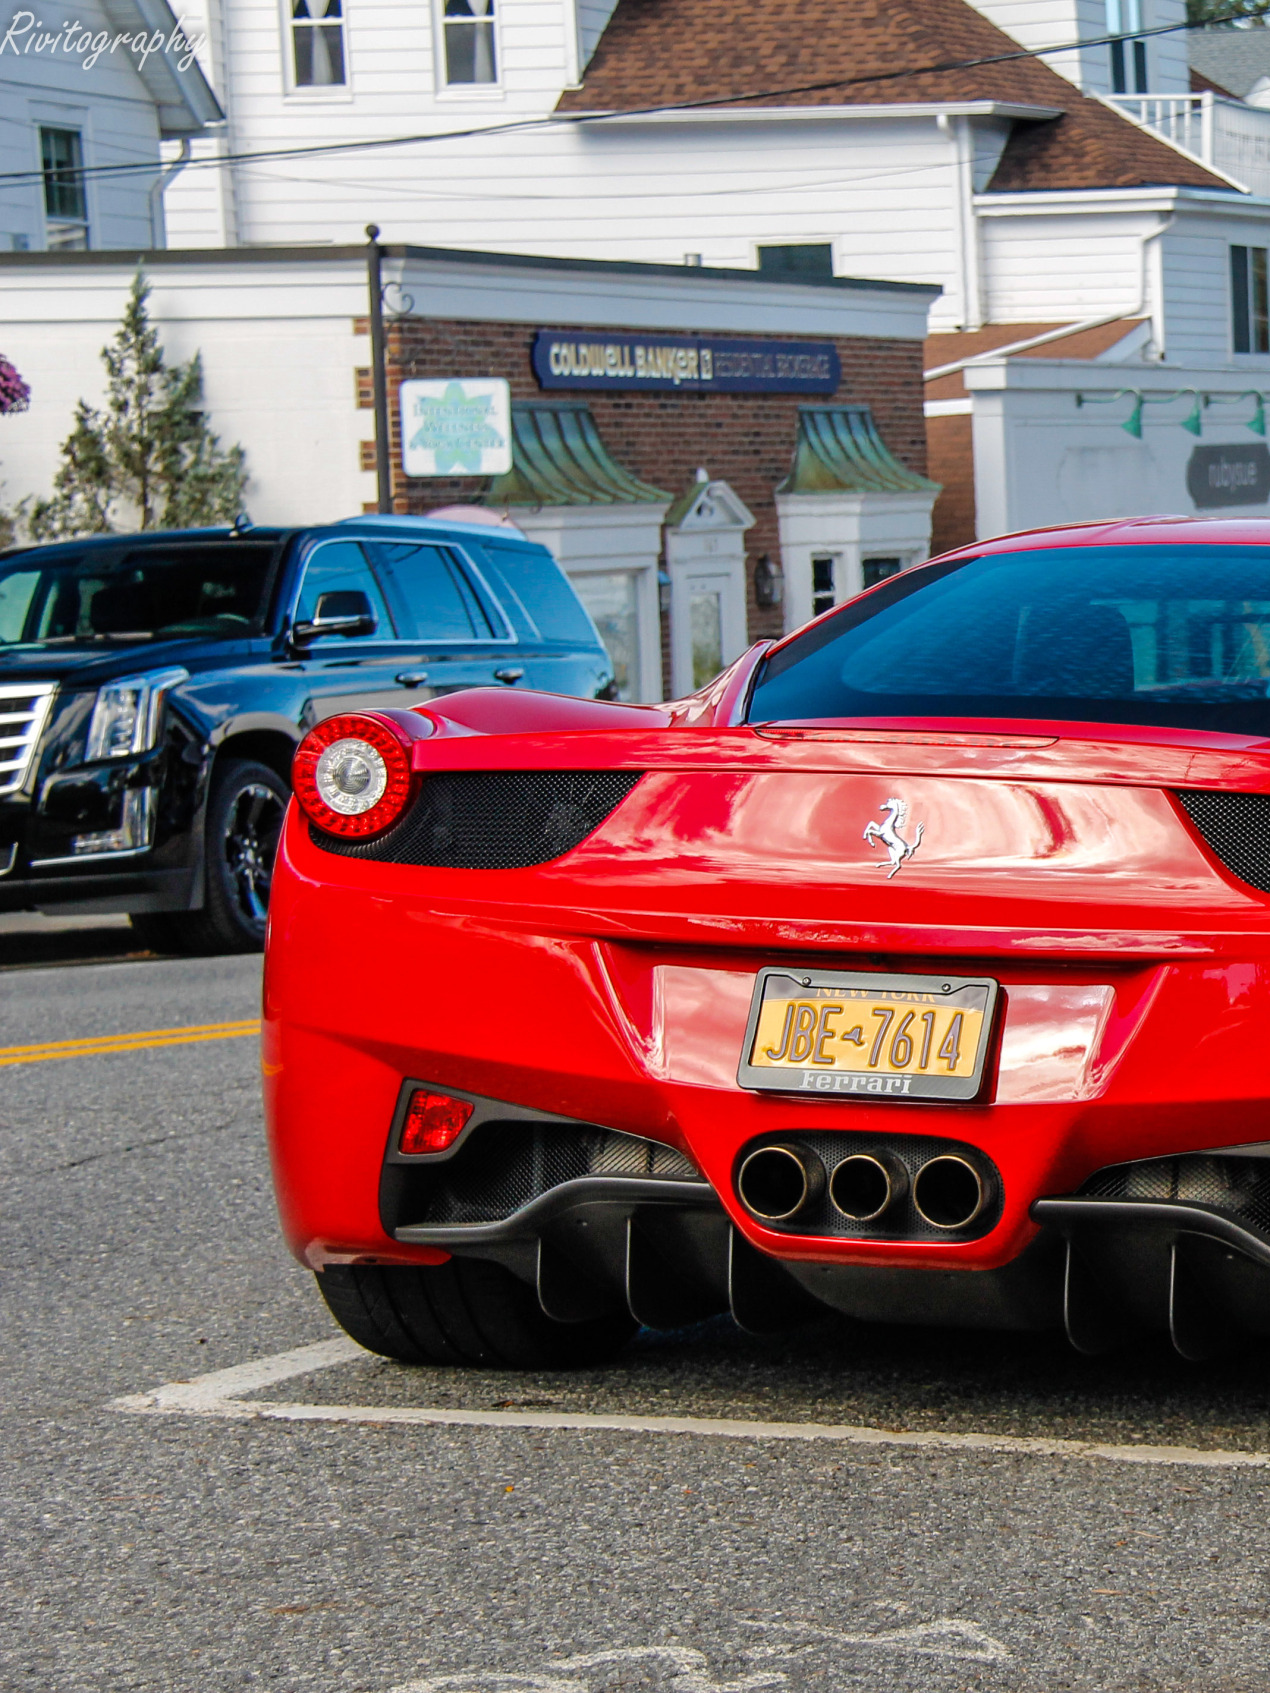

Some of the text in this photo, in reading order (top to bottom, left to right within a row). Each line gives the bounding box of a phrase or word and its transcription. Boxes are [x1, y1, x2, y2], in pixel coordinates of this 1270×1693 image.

[766, 1004, 964, 1071] JBE 7614
[799, 1070, 912, 1094] Ferrari
